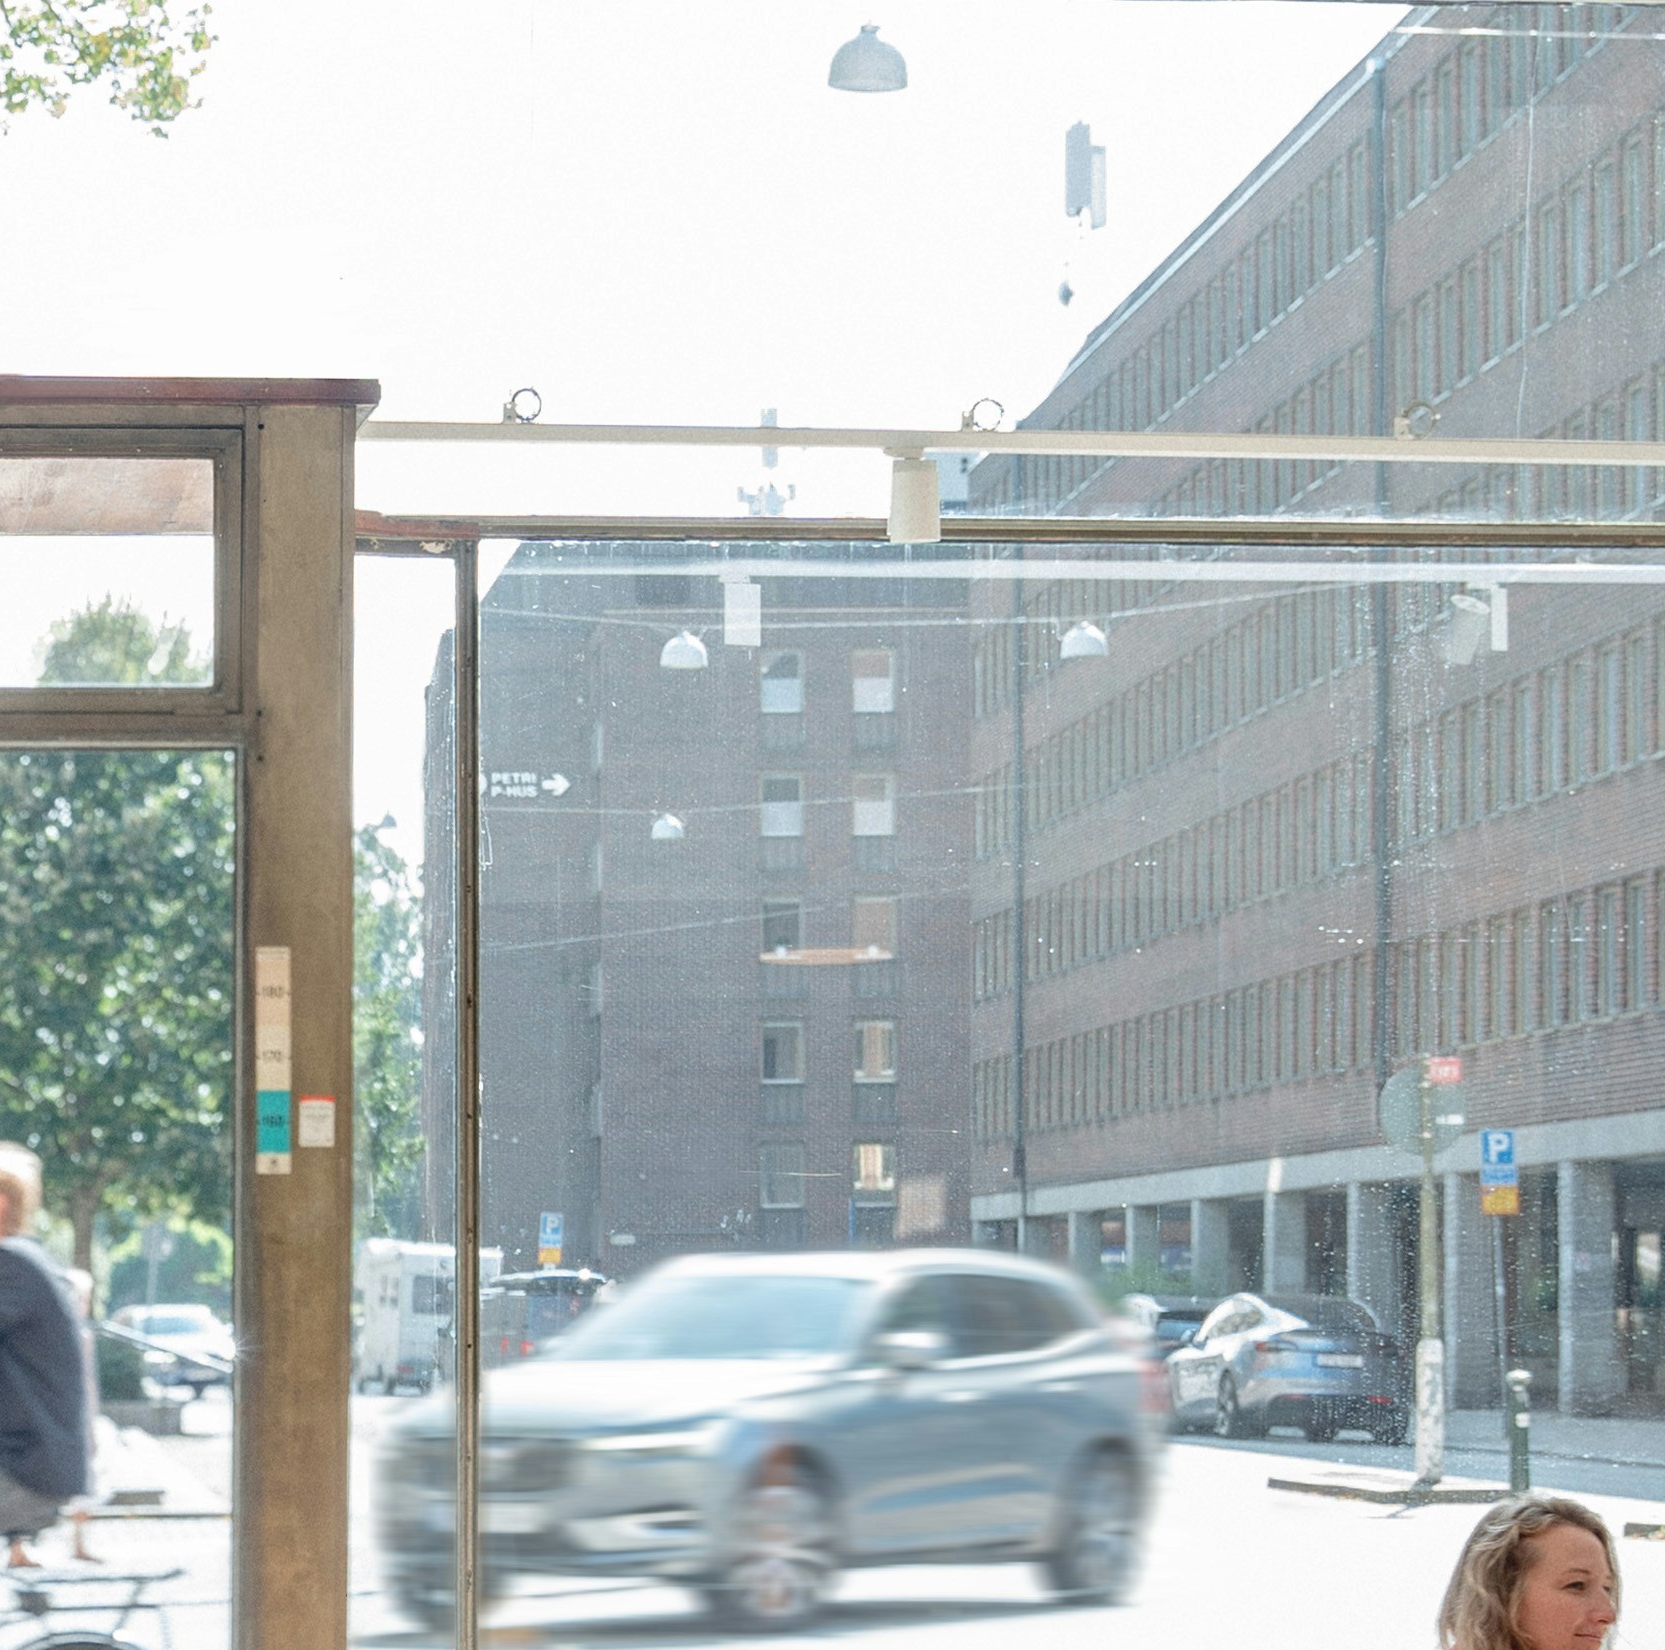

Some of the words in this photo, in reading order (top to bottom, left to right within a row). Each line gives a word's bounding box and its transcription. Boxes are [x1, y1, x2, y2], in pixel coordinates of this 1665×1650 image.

[490, 771, 537, 784] PETRI
[490, 785, 538, 798] P-HUS
[1487, 1132, 1510, 1163] P
